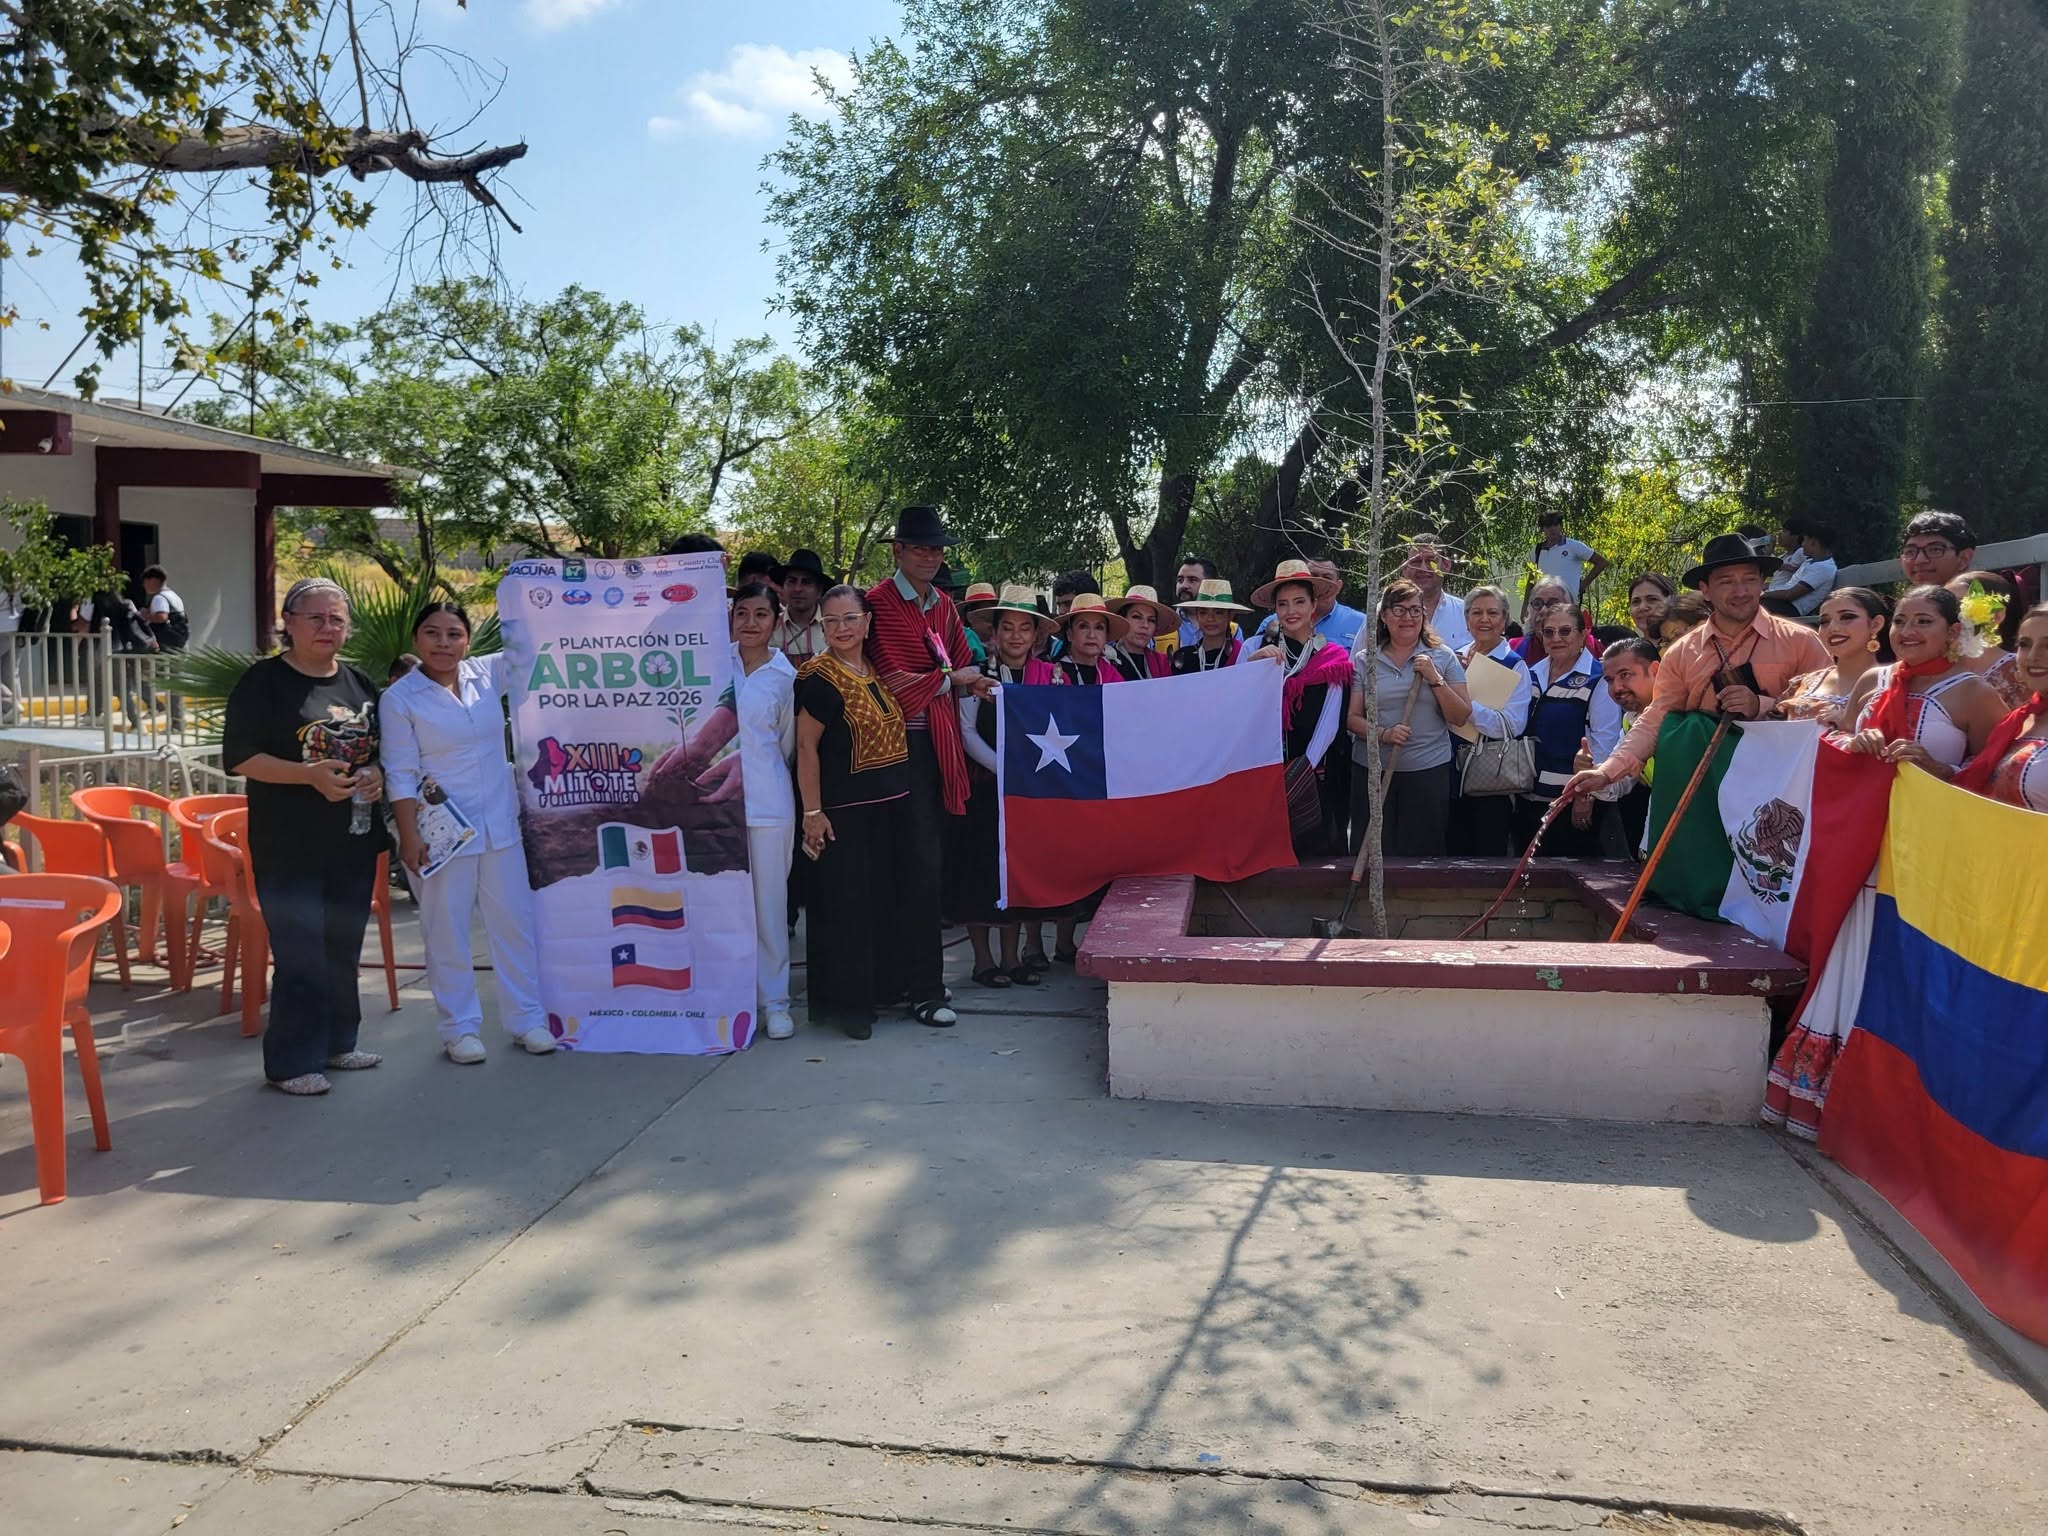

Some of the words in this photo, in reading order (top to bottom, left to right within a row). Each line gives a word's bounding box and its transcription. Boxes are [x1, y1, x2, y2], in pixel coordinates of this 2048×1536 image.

[512, 563, 557, 576] ACUÑA
[559, 632, 669, 650] PLANTACIÓN
[675, 633, 709, 646] DEL
[528, 643, 711, 691] ÁRBOL
[539, 694, 579, 709] POR
[584, 693, 607, 708] LA
[613, 692, 651, 708] PAZ
[656, 691, 703, 706] 2026
[563, 743, 620, 771] XIII
[543, 770, 636, 795] MITOTE
[685, 1010, 705, 1018] CHILE
